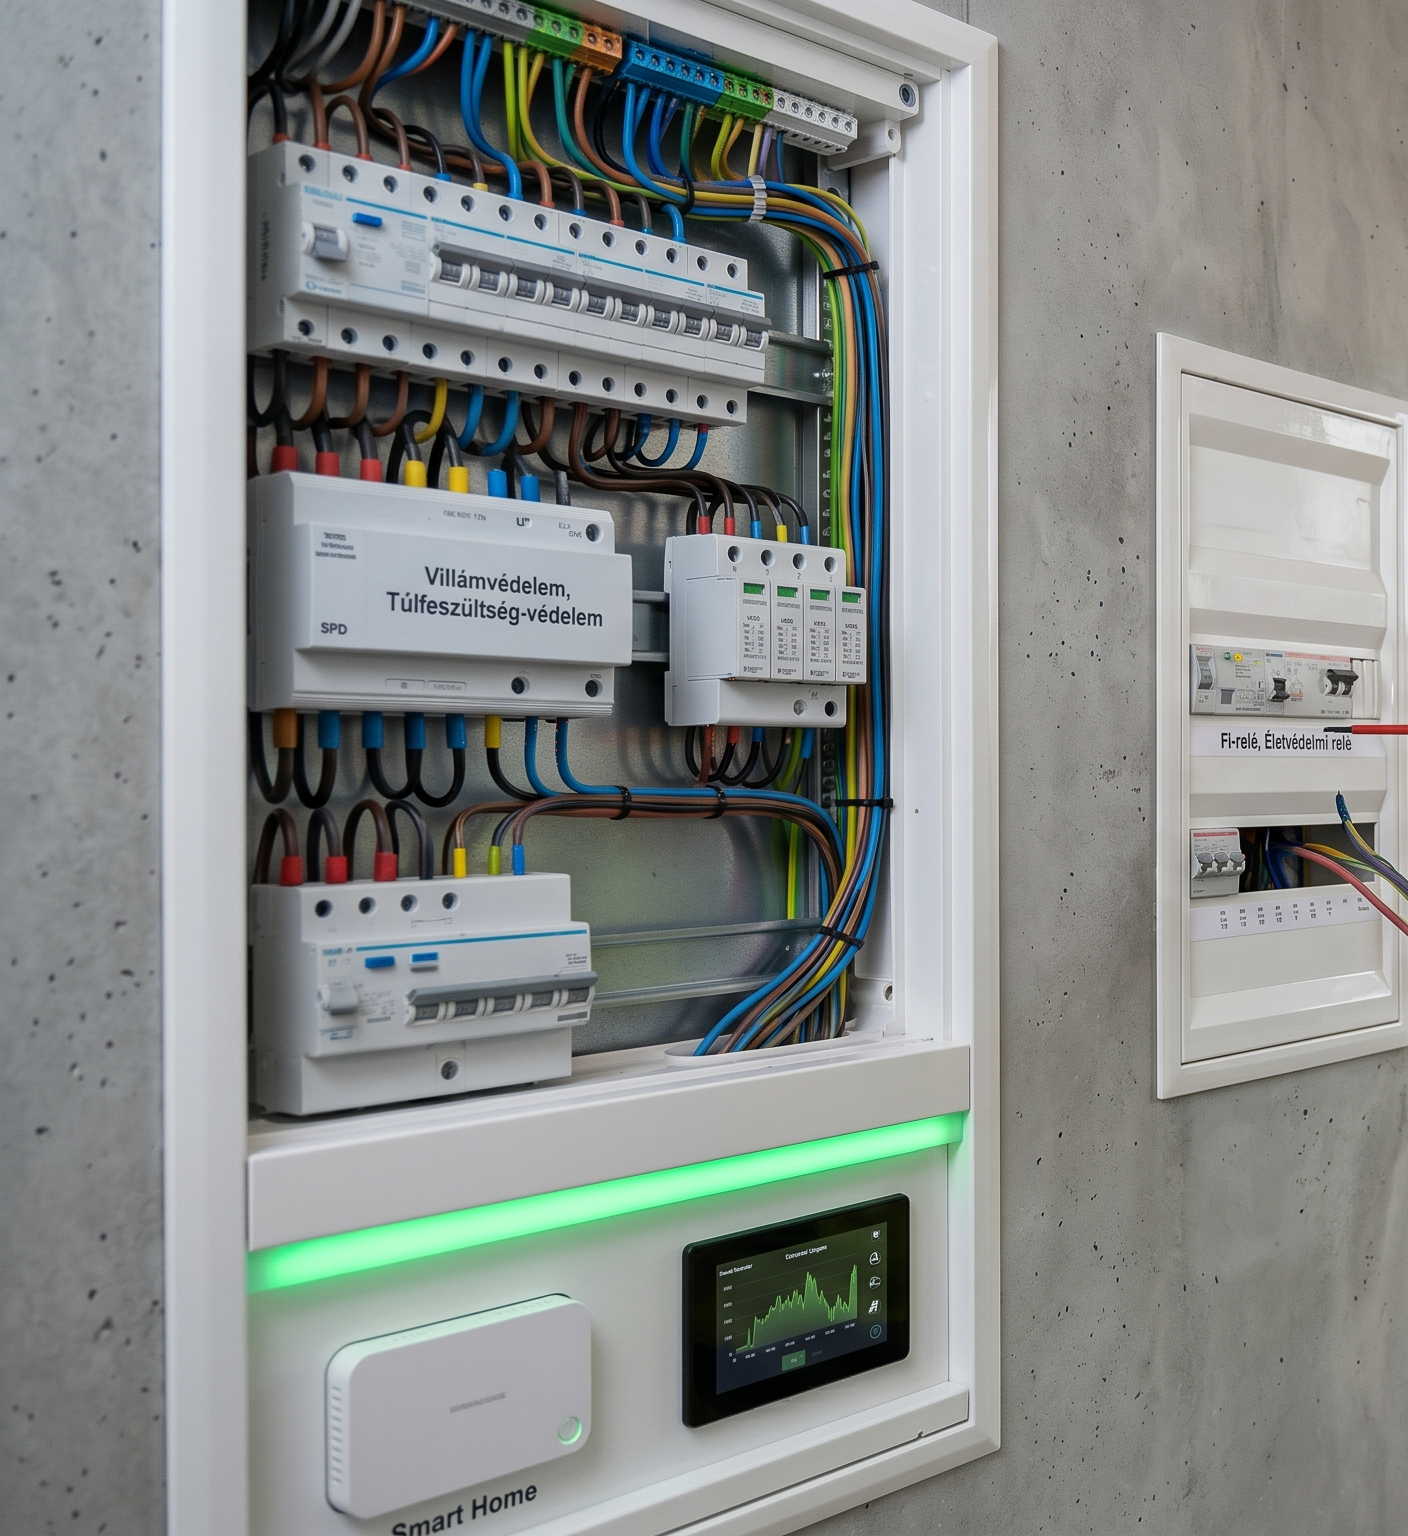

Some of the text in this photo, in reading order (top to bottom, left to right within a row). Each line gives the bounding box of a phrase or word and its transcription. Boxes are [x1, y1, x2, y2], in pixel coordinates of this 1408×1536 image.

[425, 566, 571, 601] Villámvédelem,
[386, 591, 603, 627] Túlfeszültség-védelem
[320, 622, 348, 635] SPD
[1221, 732, 1261, 751] Fi-relé,
[1265, 729, 1328, 750] Életvédelmi
[392, 1485, 537, 1536] Smart Home
